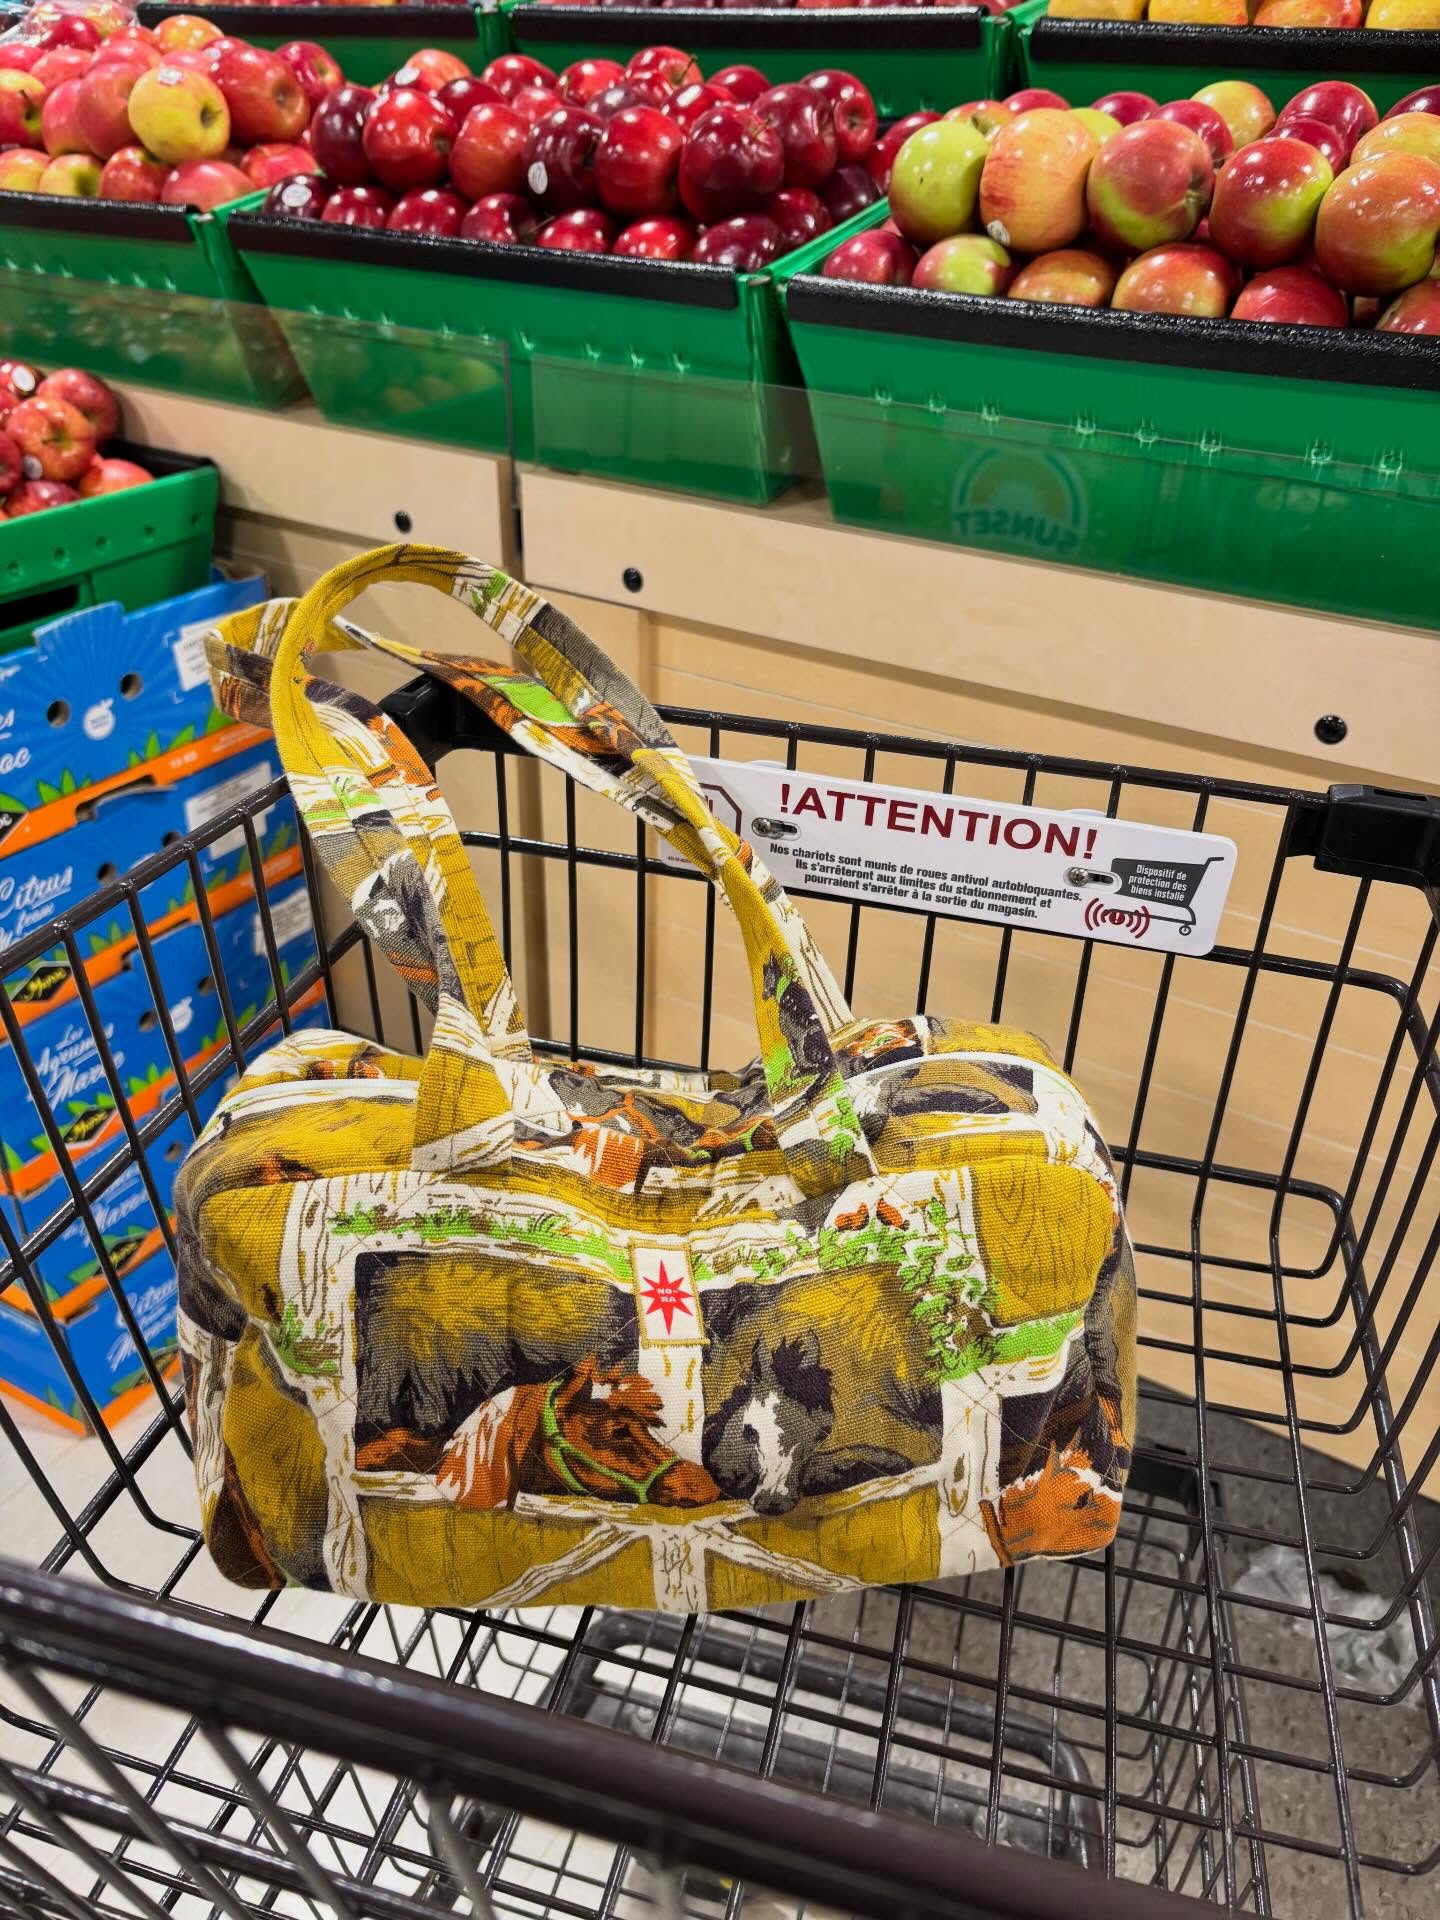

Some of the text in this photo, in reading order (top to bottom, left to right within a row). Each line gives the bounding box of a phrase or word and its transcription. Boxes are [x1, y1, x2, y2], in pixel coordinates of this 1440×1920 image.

[780, 783, 1098, 859] !ATTENTION!
[0, 865, 73, 919] Citrus
[770, 843, 1083, 901] Nos chariots sont munis de roues antivol autobloquantes.
[795, 859, 1052, 909] Ils s'arrêteront aux limites du stationnement et
[804, 873, 1038, 918] pourraient s'arrêter à la sortie du magasin.
[1128, 875, 1187, 892] protection des
[1131, 885, 1185, 902] biens installé
[1136, 864, 1187, 880] Dispositif de
